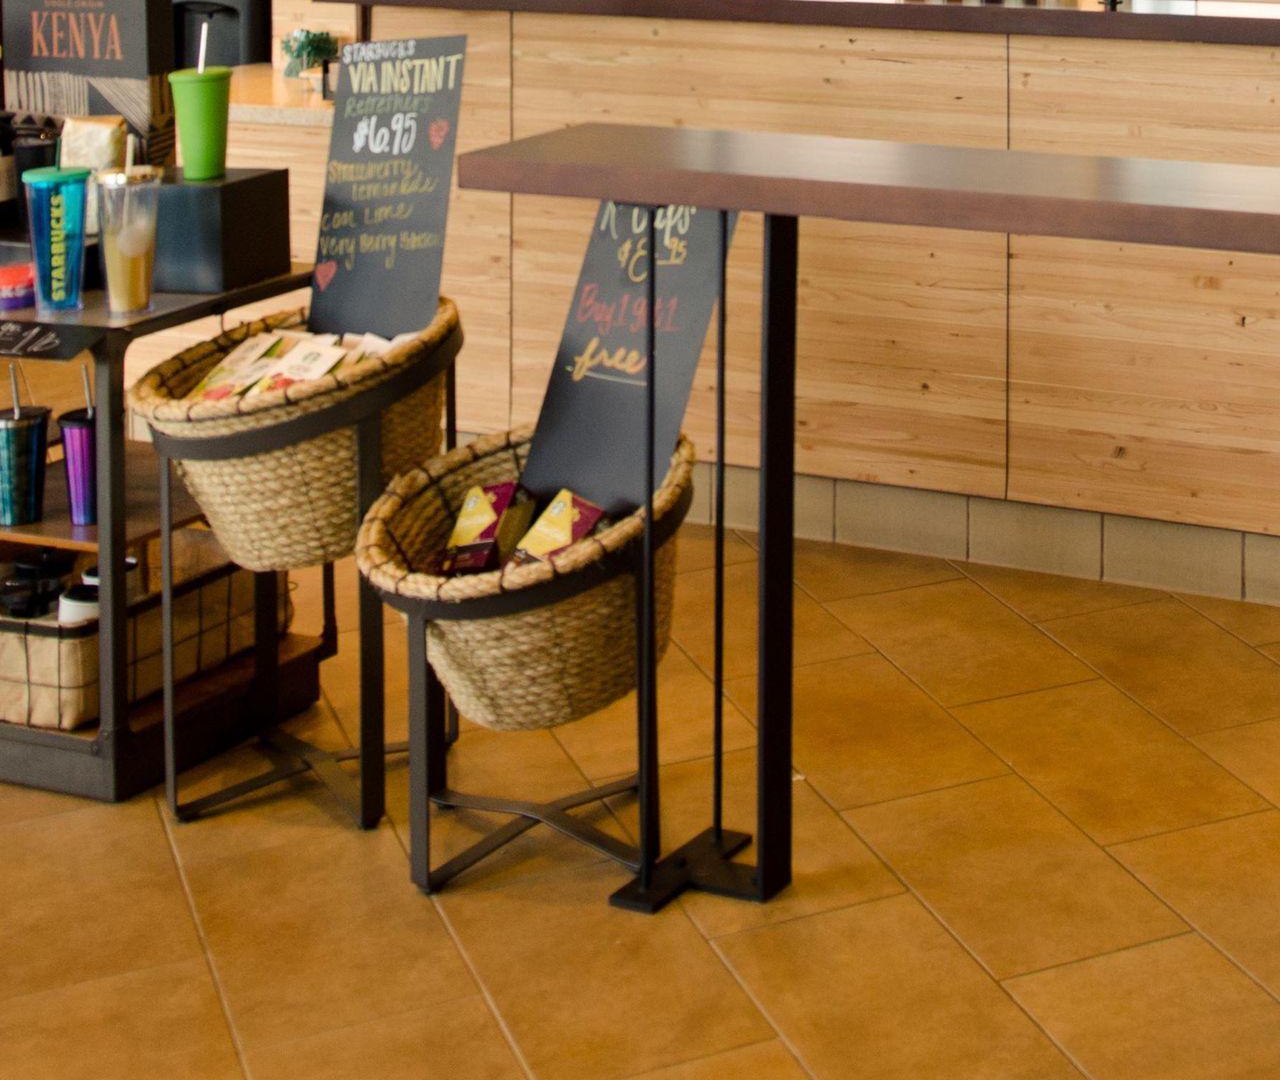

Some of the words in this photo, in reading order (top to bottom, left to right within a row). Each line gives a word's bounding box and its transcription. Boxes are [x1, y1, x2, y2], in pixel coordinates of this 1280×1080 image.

[31, 10, 123, 61] KENYA
[342, 39, 417, 64] STARBUCKS
[349, 62, 379, 95] VIA
[380, 53, 464, 95] INSTANT
[351, 111, 420, 156] $6.95
[50, 194, 66, 302] STARBUCKS
[629, 295, 666, 334] gt
[571, 336, 648, 382] free
